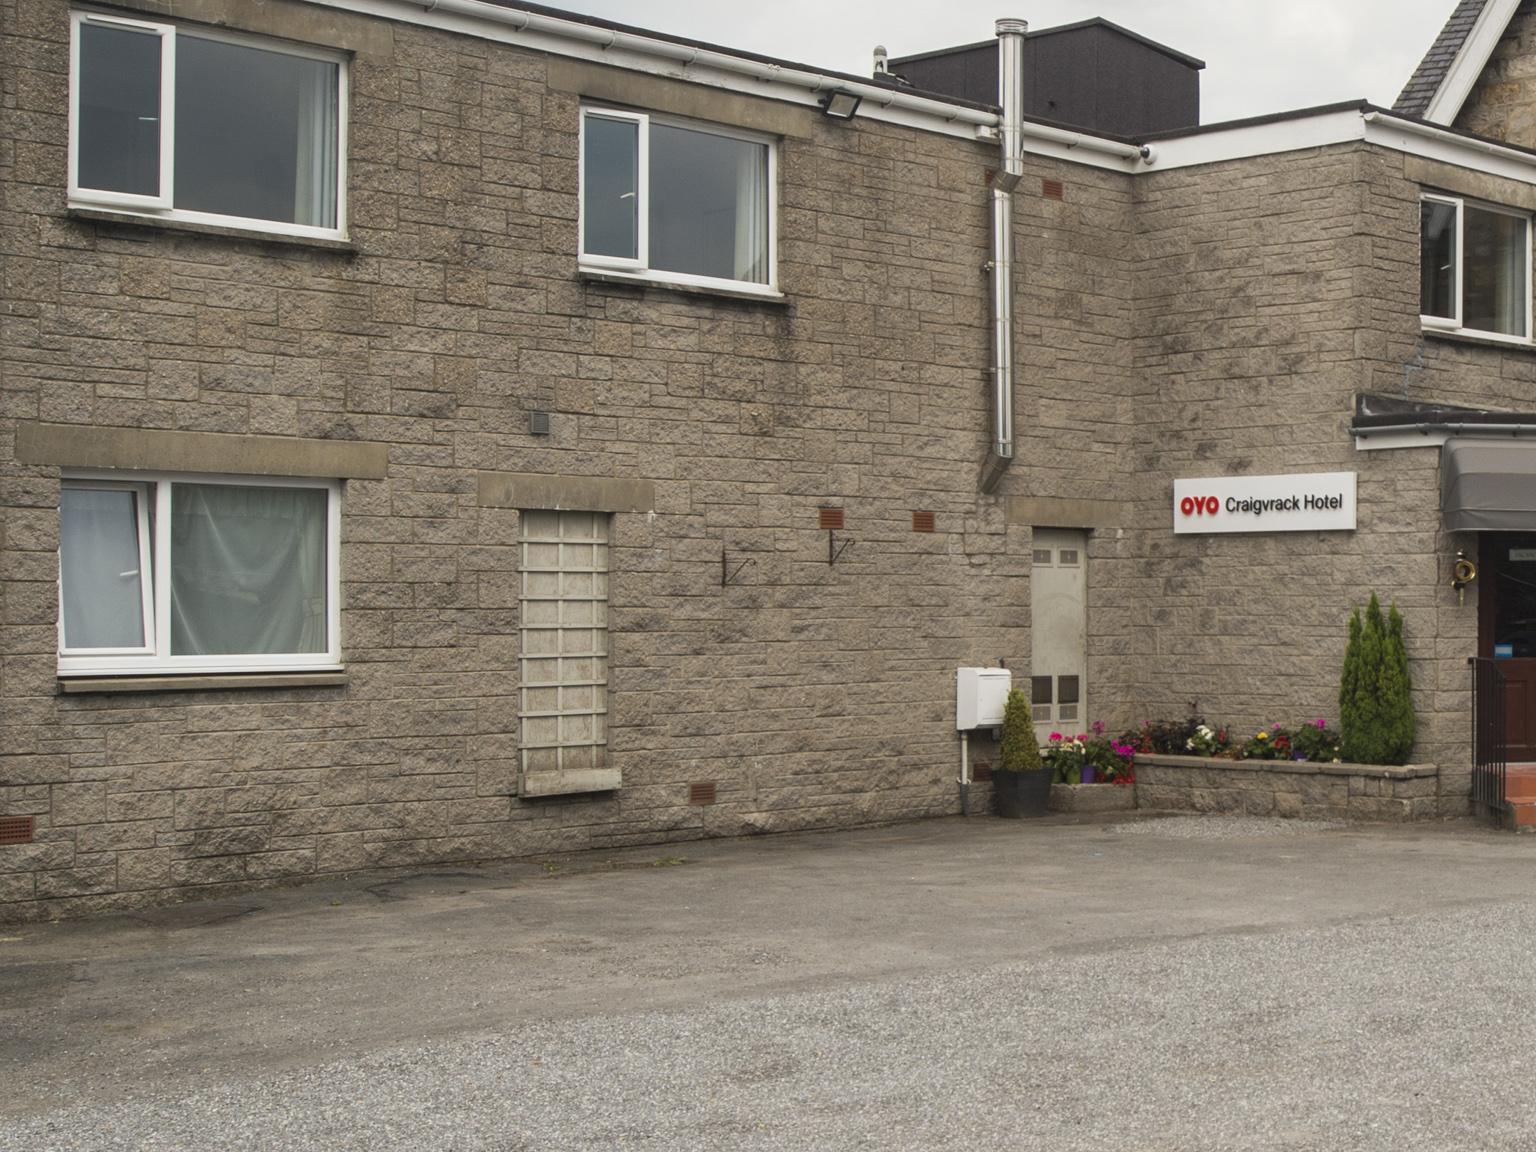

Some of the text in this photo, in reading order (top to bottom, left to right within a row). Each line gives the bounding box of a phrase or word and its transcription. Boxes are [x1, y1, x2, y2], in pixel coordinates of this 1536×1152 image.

[1180, 493, 1343, 516] OYO Craigvrack Hotel
